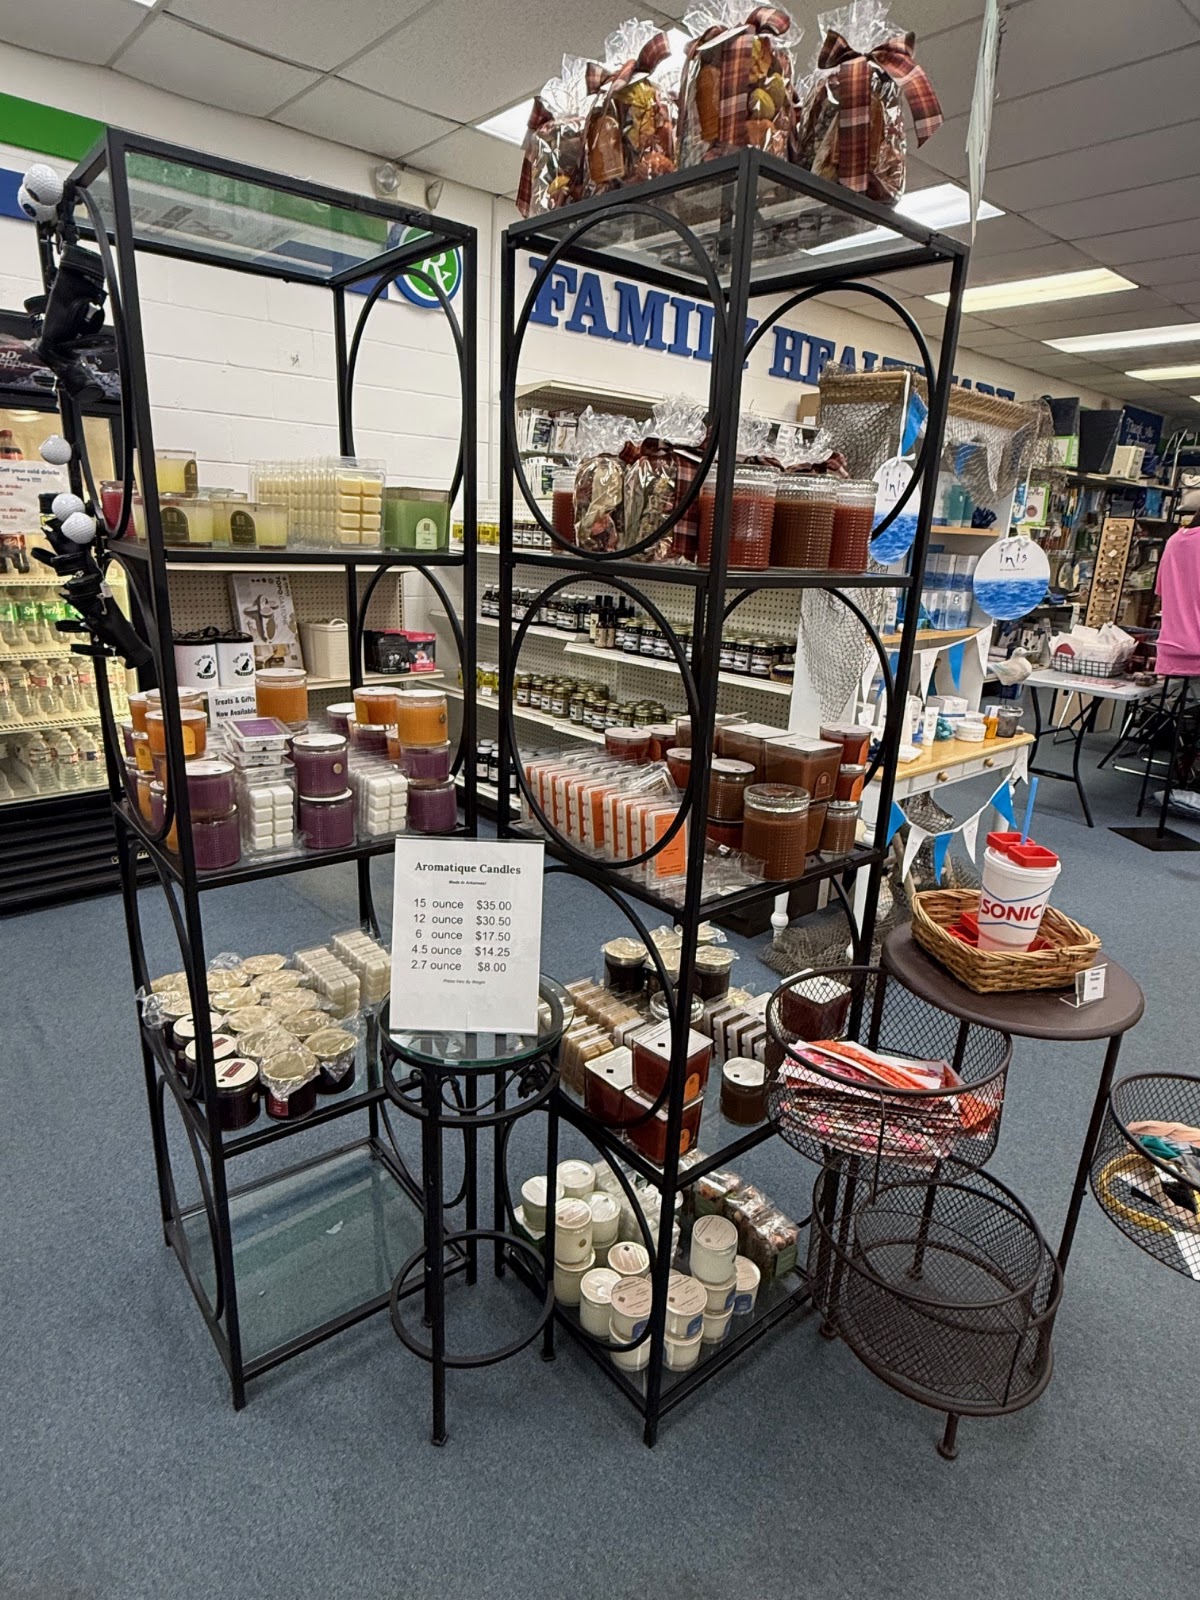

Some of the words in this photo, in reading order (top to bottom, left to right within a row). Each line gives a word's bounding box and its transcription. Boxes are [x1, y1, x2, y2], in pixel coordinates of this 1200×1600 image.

[214, 698, 234, 706] Treats
[234, 696, 240, 704] &
[240, 695, 256, 704] Gifts
[230, 707, 257, 716] Available
[414, 861, 477, 875] Aromatique
[479, 863, 522, 875] Candles
[414, 898, 427, 909] 15
[432, 899, 464, 910] ounce
[476, 899, 512, 911] $35.00
[980, 898, 1043, 922] SONIC
[413, 914, 426, 924] 12
[431, 916, 464, 925] ounce
[475, 915, 511, 927] $30.50
[415, 928, 423, 939] 6
[431, 931, 463, 941] ounce
[475, 931, 511, 942] $17.50
[411, 944, 428, 955] 4.5
[430, 946, 462, 956] ounce
[474, 946, 511, 958] $14.25
[411, 959, 428, 970] 2.7
[430, 961, 462, 971] ounce
[477, 961, 507, 973] $8.00
